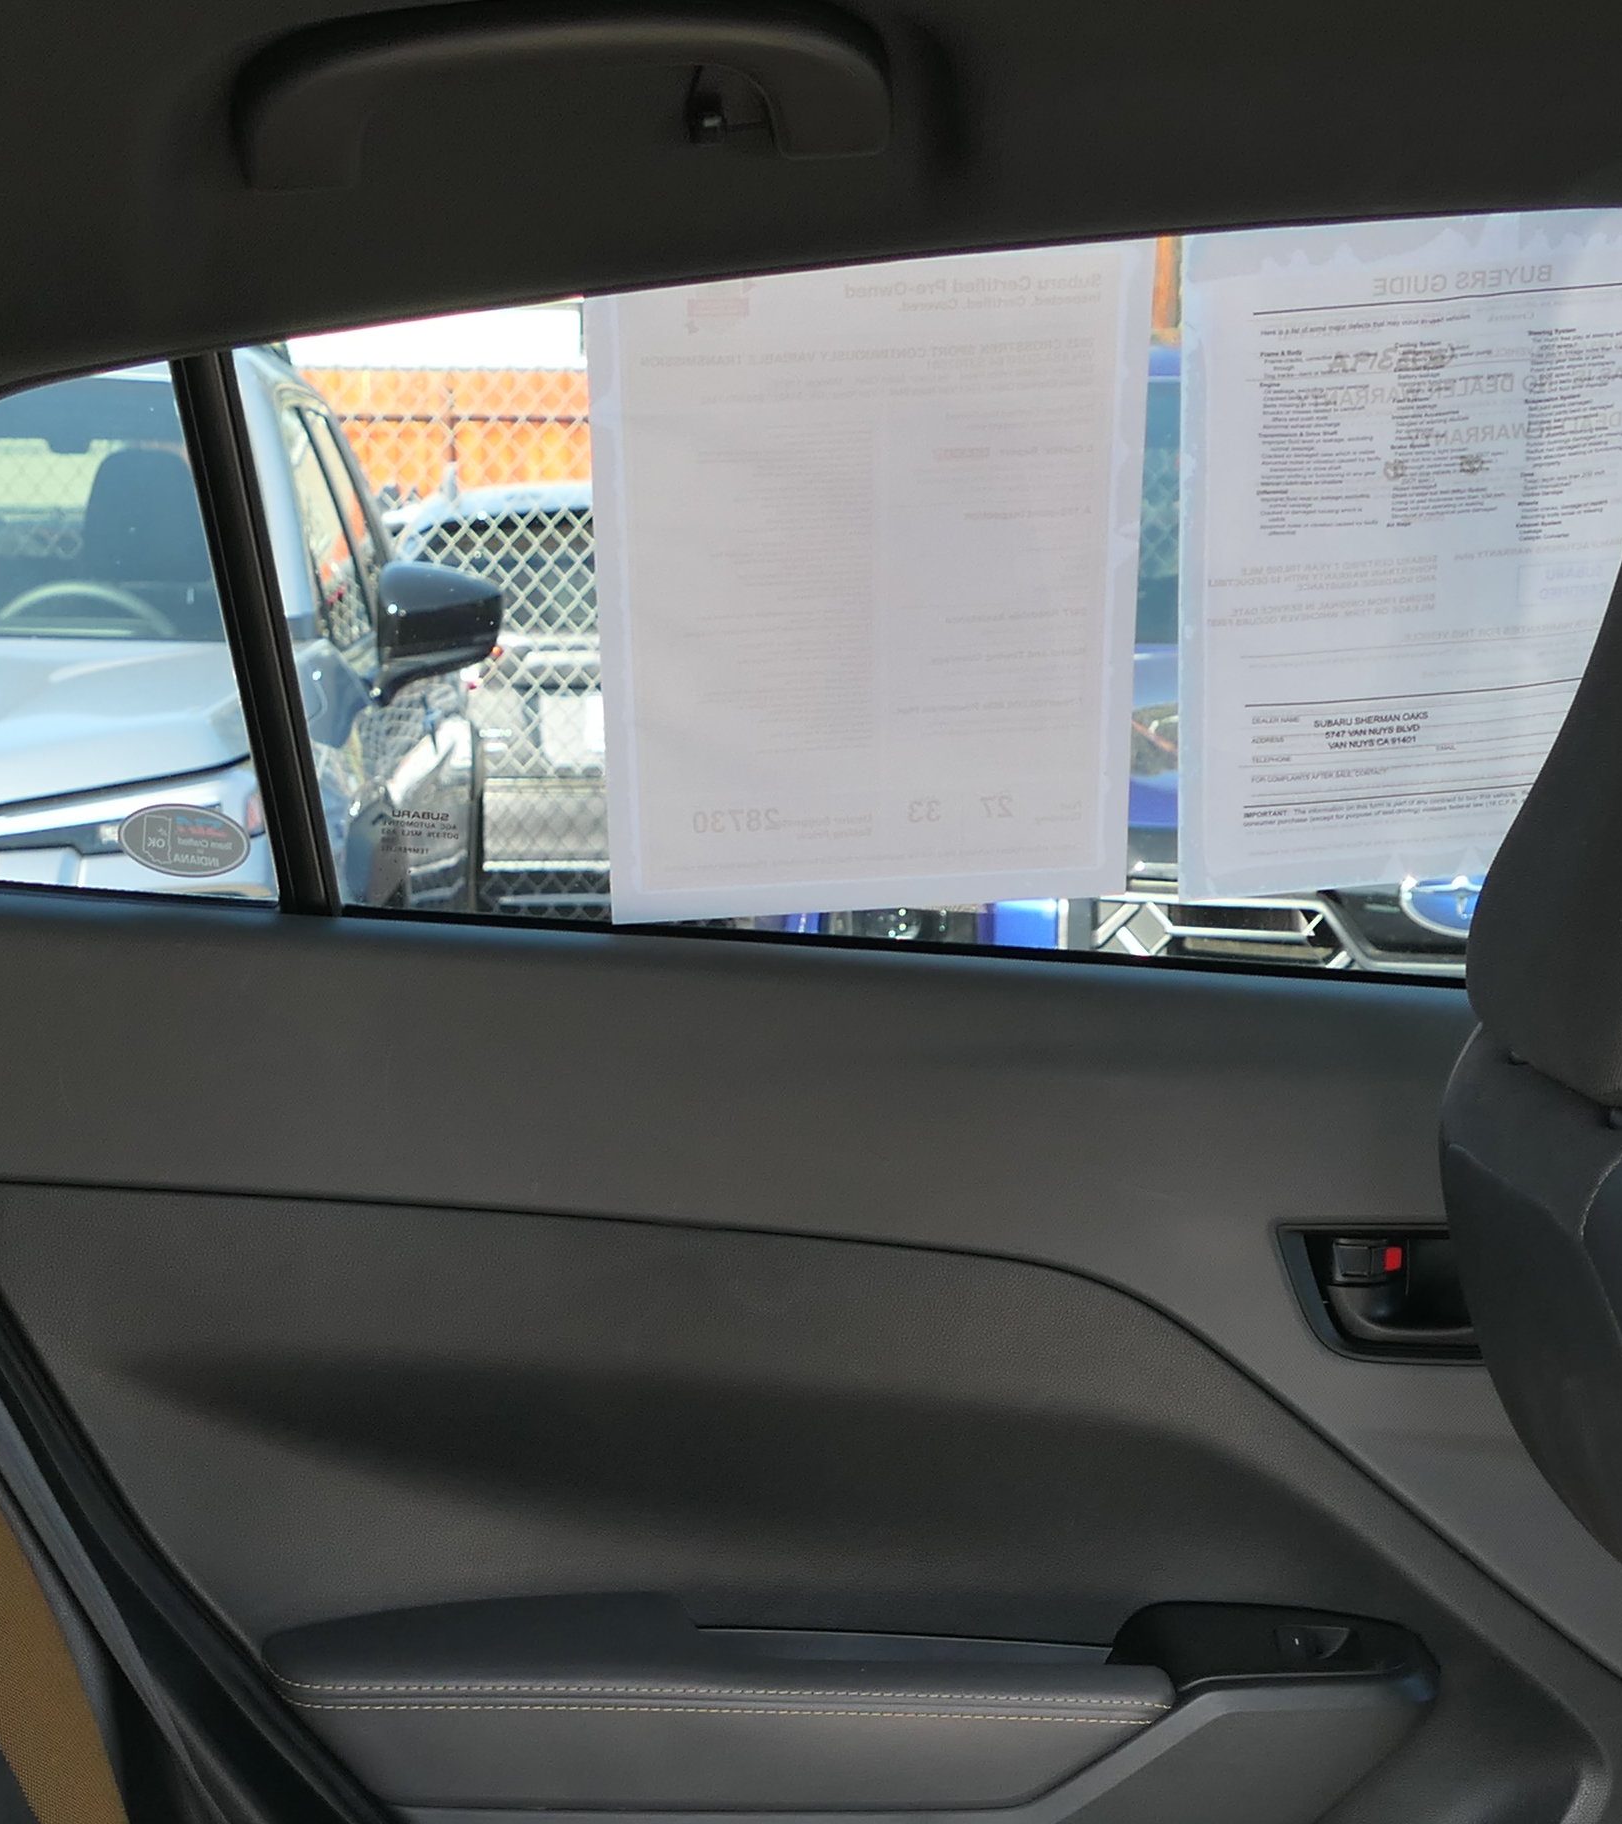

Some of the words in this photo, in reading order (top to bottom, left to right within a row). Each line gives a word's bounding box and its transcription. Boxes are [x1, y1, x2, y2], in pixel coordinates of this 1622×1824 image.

[1314, 718, 1351, 728] SUBARU
[1354, 714, 1400, 725] SHERMAN
[1403, 711, 1428, 721] OAKS
[1325, 730, 1346, 739] 5747
[1348, 729, 1366, 738] VAN
[1369, 727, 1394, 736] NUYS
[1397, 724, 1420, 734] BLVD
[1252, 736, 1284, 744] ADDRESS
[1328, 741, 1347, 749] VAN
[1349, 740, 1375, 748] NUYS
[1377, 738, 1389, 746] CA
[1391, 735, 1416, 745] 91401
